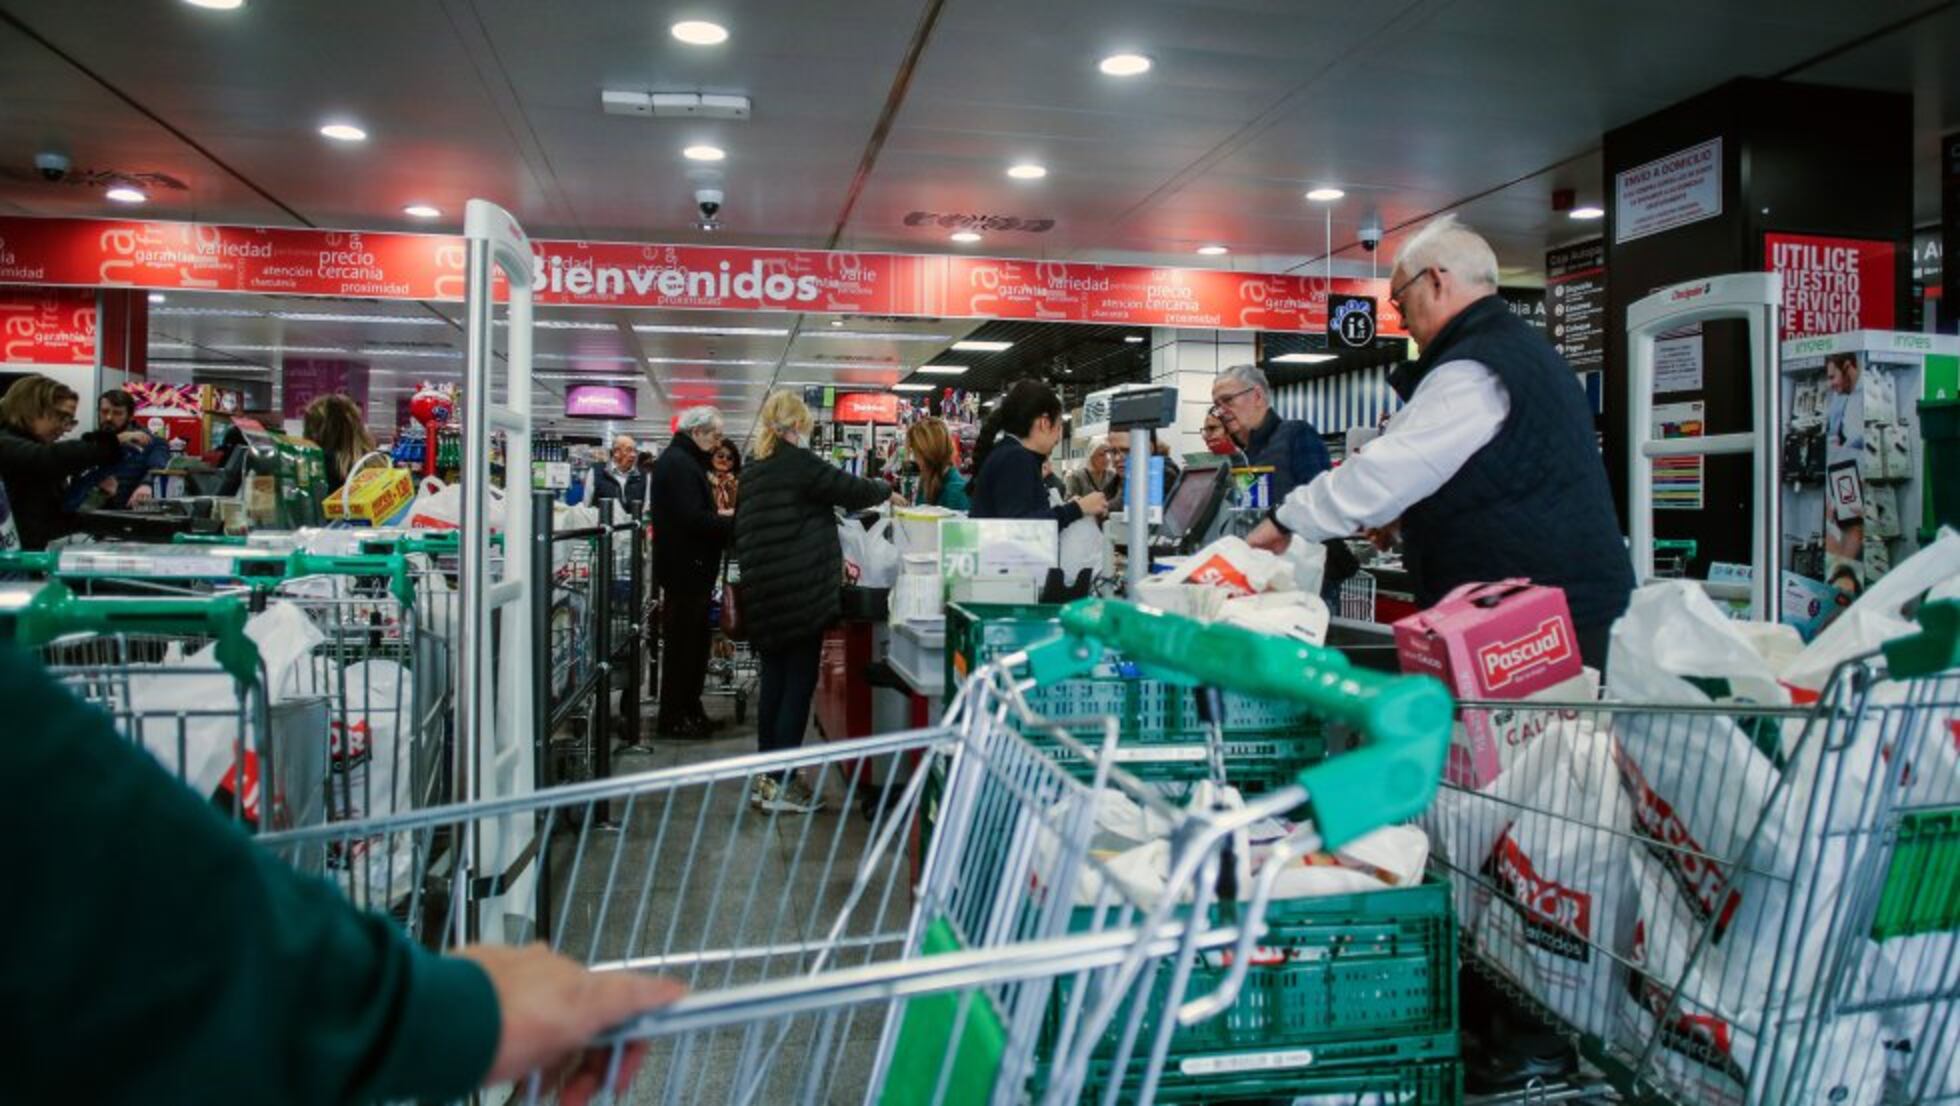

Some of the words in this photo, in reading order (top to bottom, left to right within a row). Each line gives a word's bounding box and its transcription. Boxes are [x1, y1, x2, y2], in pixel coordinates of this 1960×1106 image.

[196, 241, 272, 257] variedad
[319, 249, 375, 271] precio
[1773, 242, 1860, 273] UTILICE
[262, 264, 312, 277] atención
[531, 255, 819, 301] Bienvenidos
[839, 266, 877, 282] varie
[341, 281, 410, 294] proximidad
[1048, 276, 1109, 291] variedad
[1147, 285, 1192, 302] precio
[1779, 289, 1861, 316] ERVICIO
[1165, 313, 1221, 325] proximidad
[1485, 626, 1561, 675] Pascual
